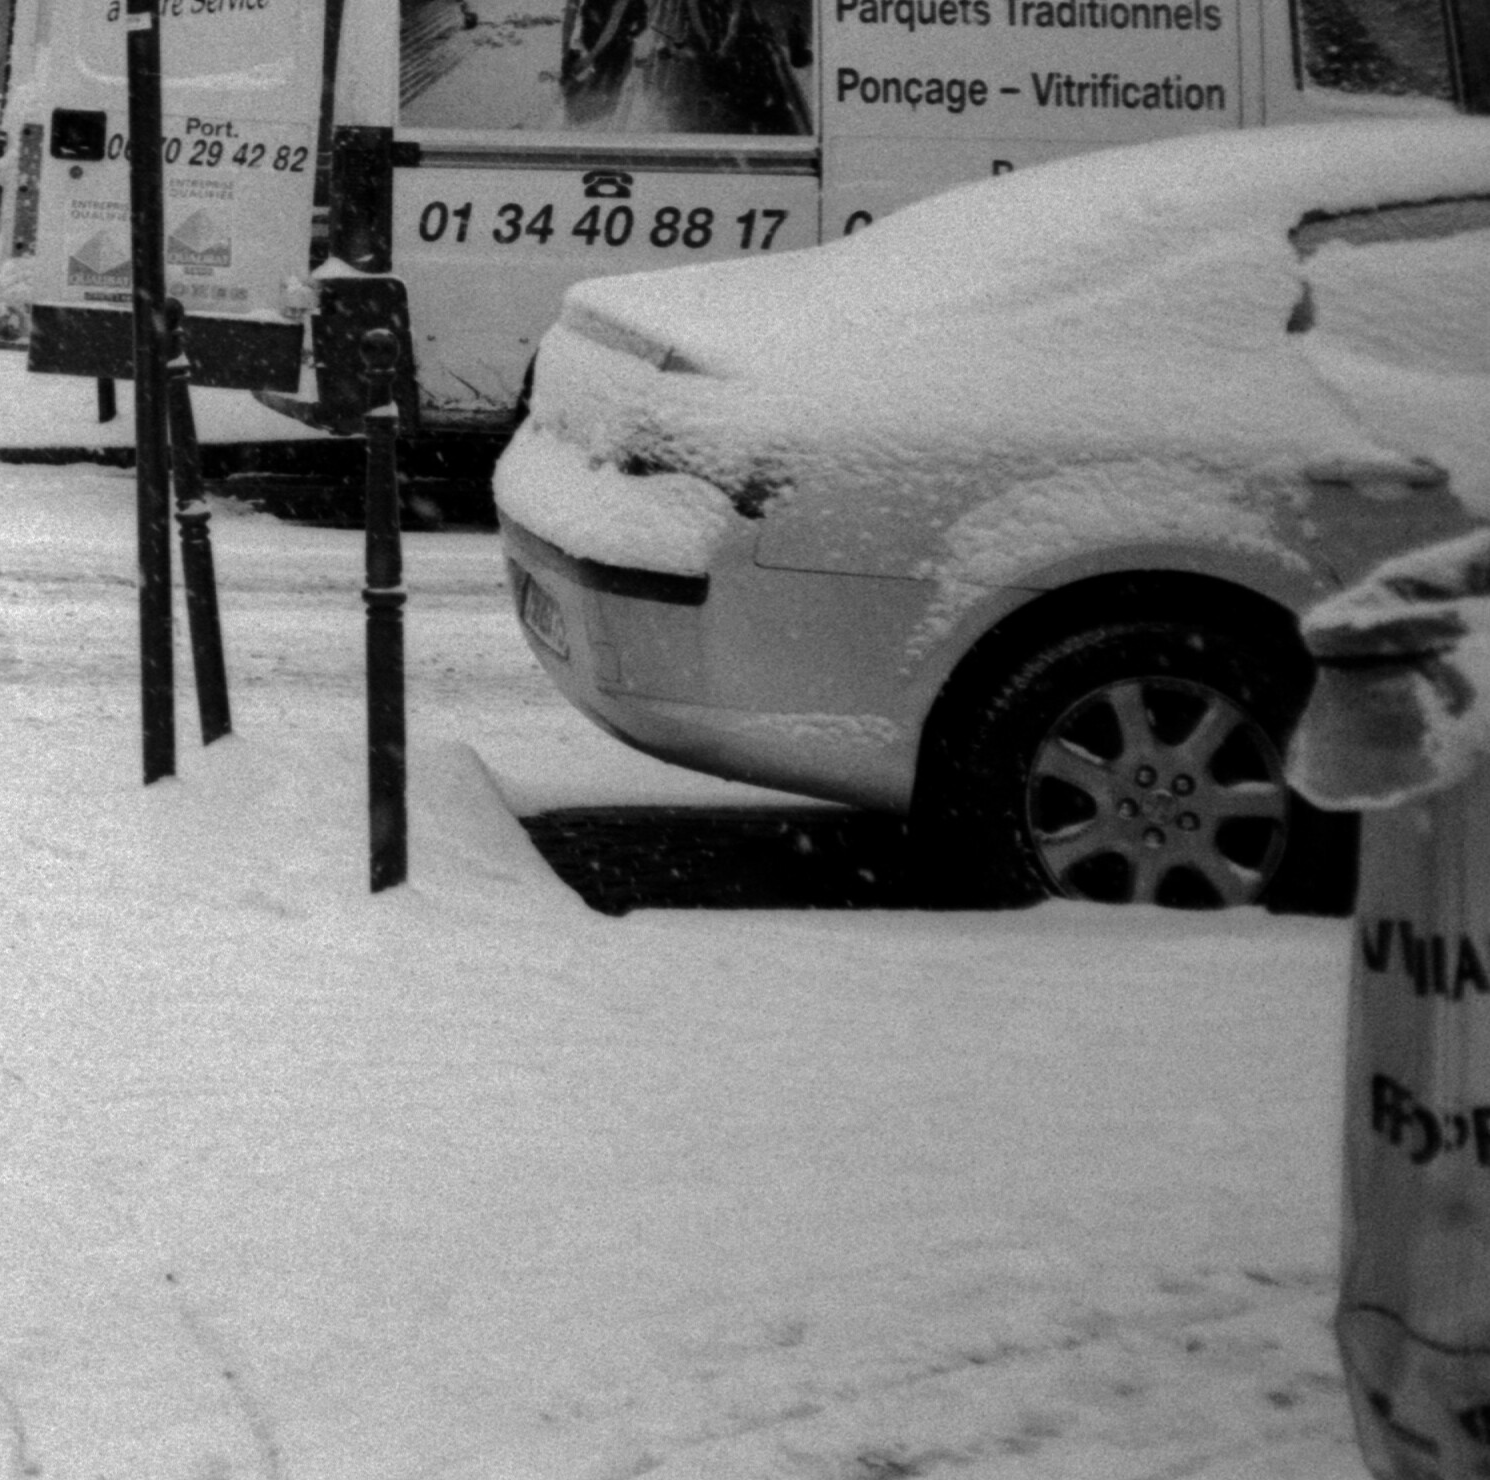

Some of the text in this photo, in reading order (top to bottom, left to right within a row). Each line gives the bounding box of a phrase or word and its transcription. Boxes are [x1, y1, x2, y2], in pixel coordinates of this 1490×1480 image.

[835, 68, 989, 113] Ponçage
[1031, 73, 1227, 113] Vitrification
[185, 117, 239, 139] Port.
[188, 139, 224, 167] 29
[232, 142, 266, 169] 42
[272, 145, 309, 173] 82
[419, 201, 788, 250] 01 34 40 88 17
